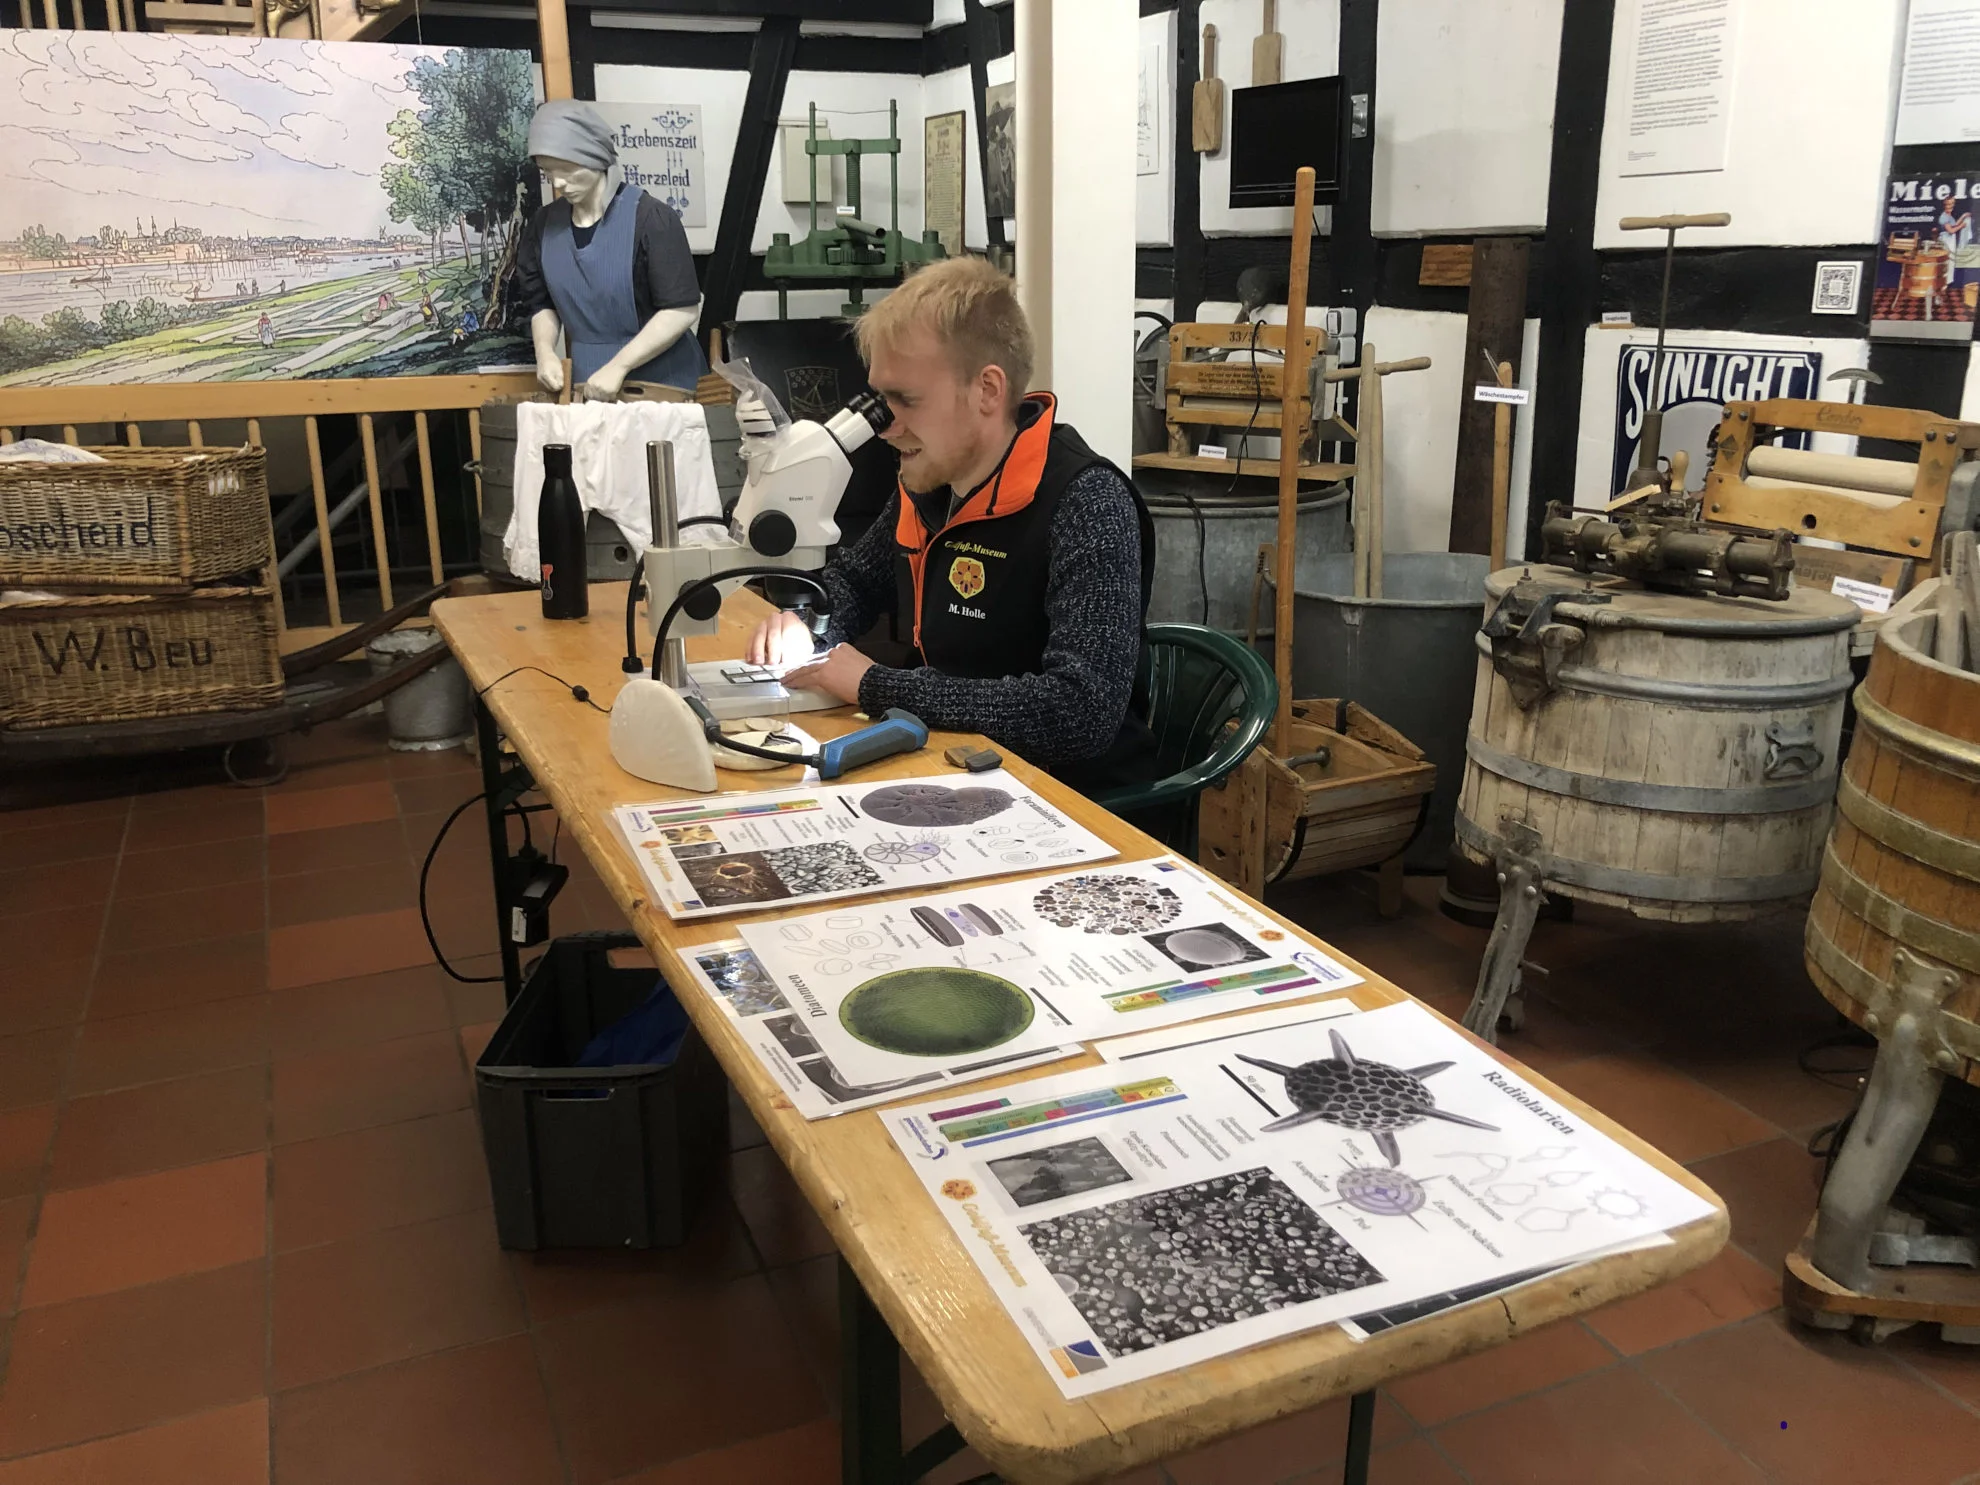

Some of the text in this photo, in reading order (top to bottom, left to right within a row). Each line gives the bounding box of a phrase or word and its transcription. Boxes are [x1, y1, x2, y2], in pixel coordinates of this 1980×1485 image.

[1890, 179, 1980, 201] Miele
[1229, 331, 1260, 343] 33/
[1479, 391, 1525, 401] Wäschestampfer
[1625, 350, 1804, 439] SUNLIGHT
[945, 540, 1008, 559] Gfuß-Museum
[948, 603, 986, 619] M. Holle
[788, 974, 828, 1018] Diatomeen
[1481, 1071, 1575, 1135] Radiolarien
